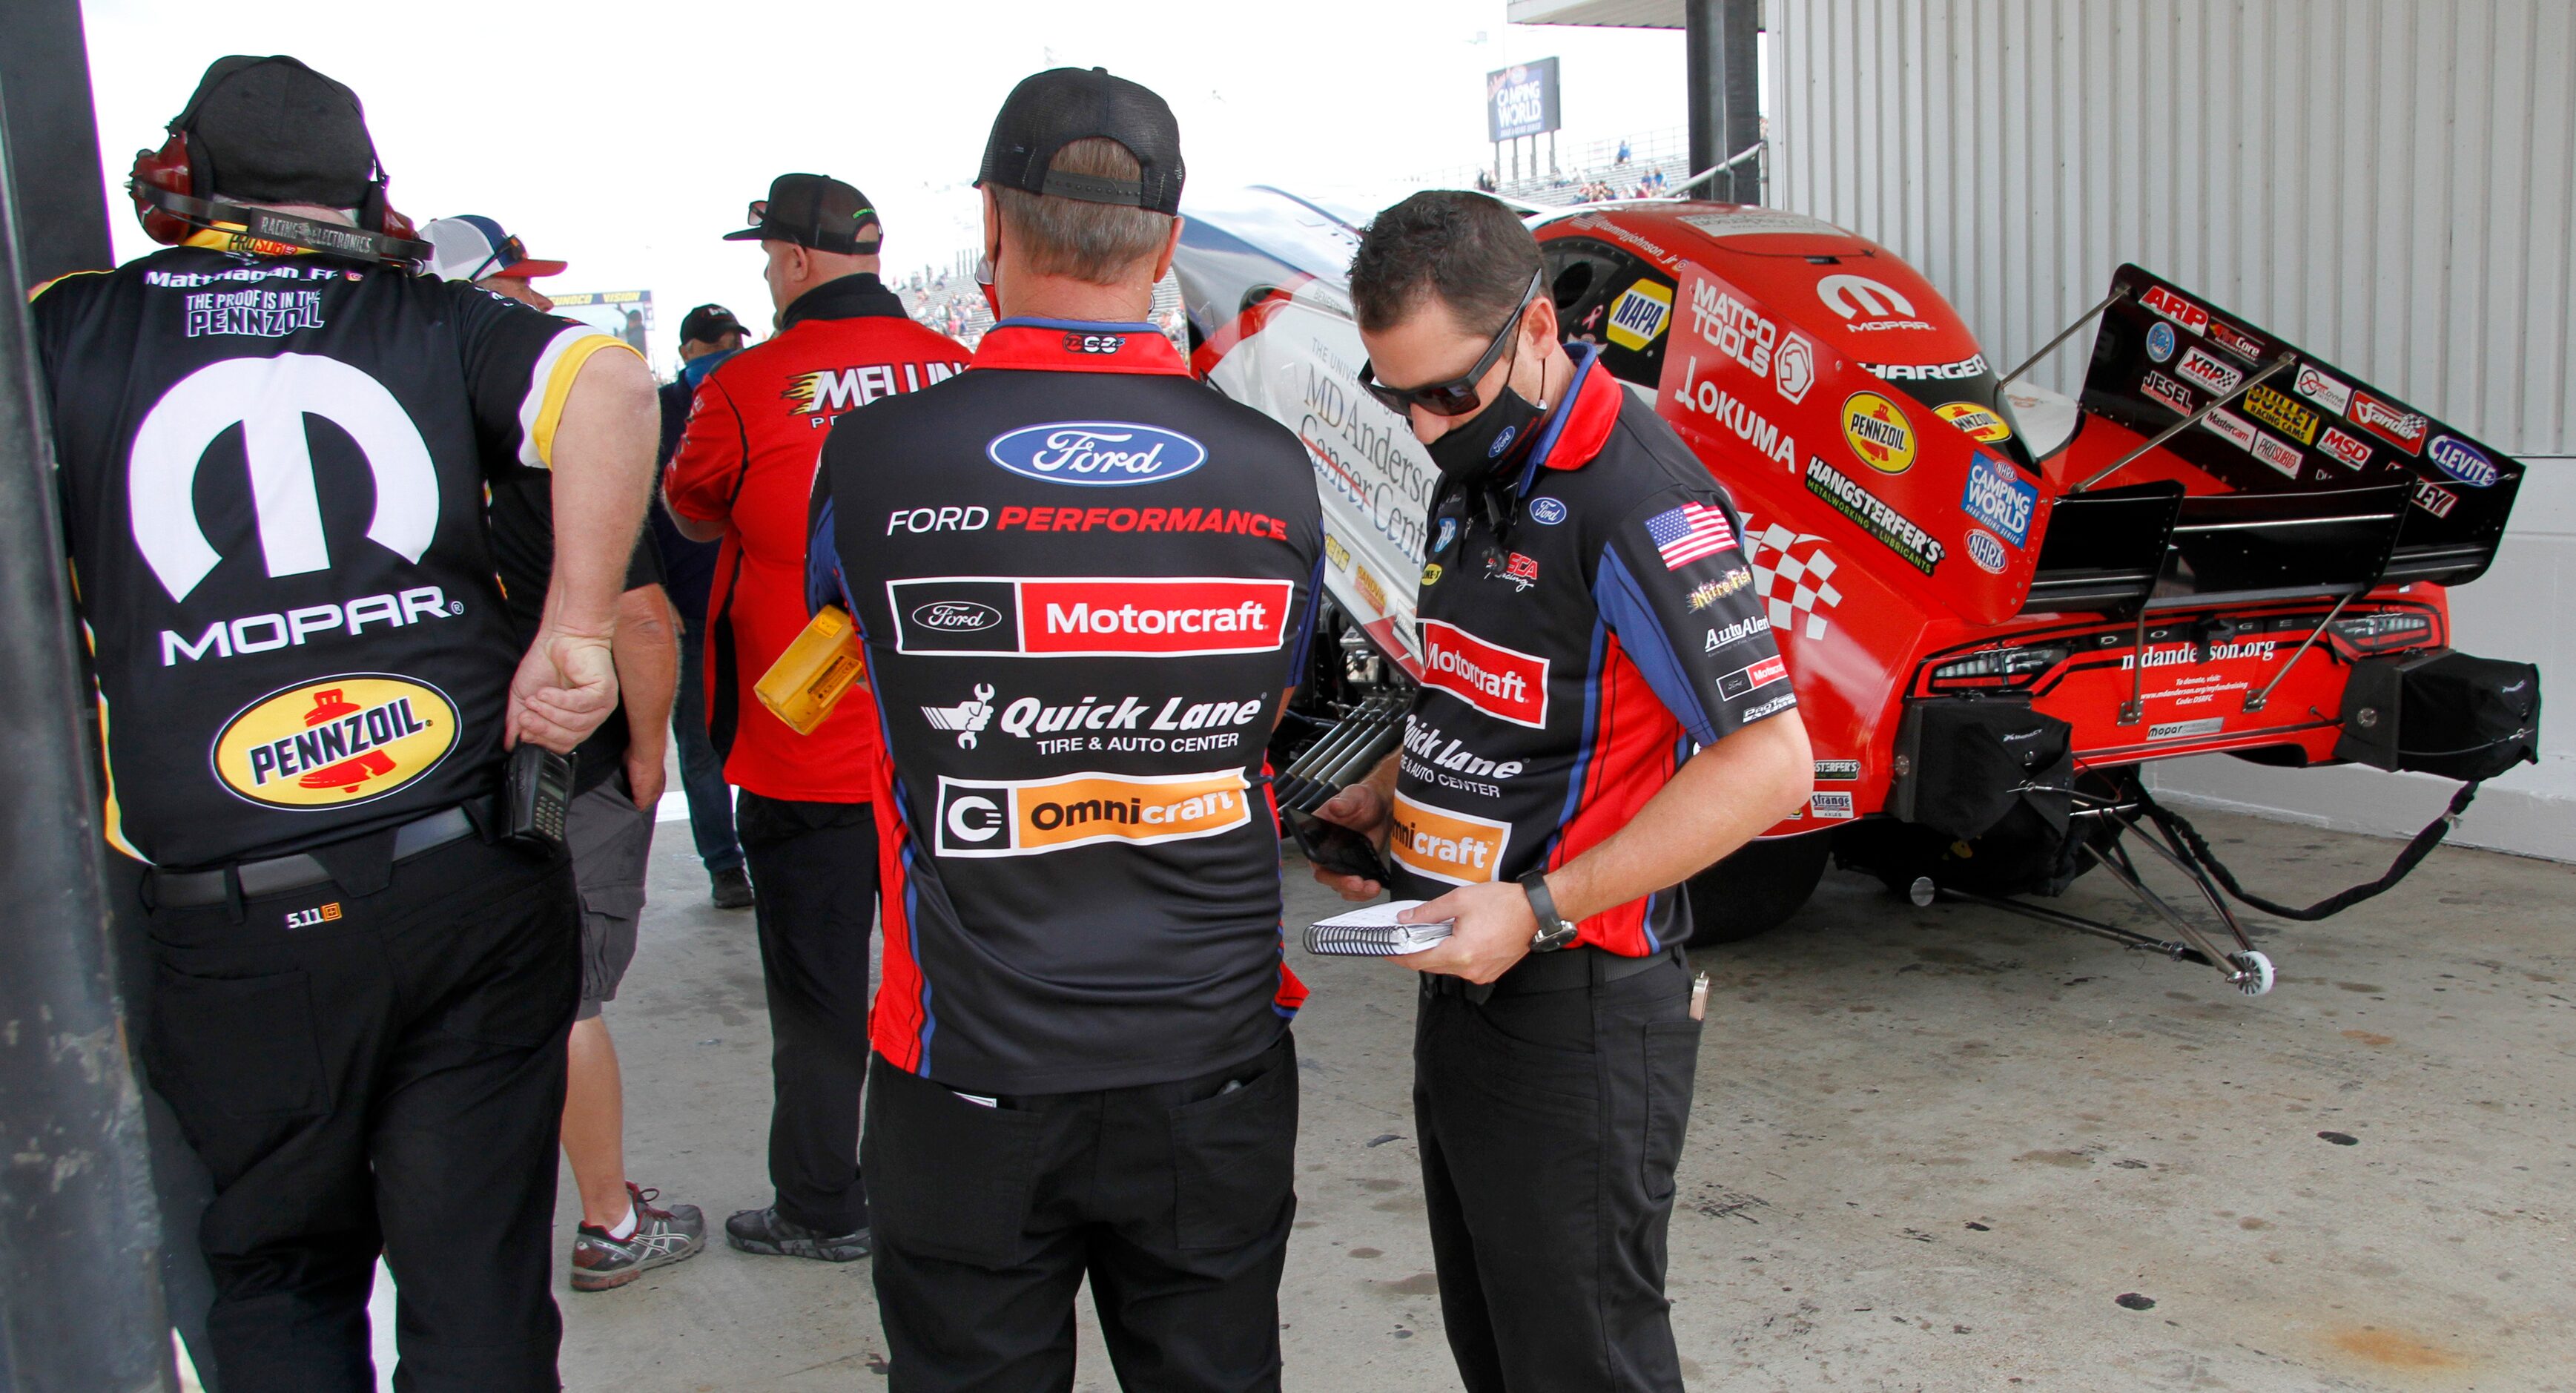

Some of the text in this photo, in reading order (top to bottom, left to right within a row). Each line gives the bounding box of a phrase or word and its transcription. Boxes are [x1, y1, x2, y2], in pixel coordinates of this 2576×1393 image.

[1497, 80, 1540, 107] CAMPING
[1498, 99, 1542, 127] WORLD
[311, 225, 373, 254] ELECTRONICS
[187, 288, 322, 312] THE PROOF IS IN THE
[603, 292, 641, 303] VISION
[1692, 277, 1777, 349] MATCO
[2141, 288, 2208, 326] ARP
[188, 300, 326, 338] PENNZOIL
[1614, 294, 1664, 337] NAPA
[1846, 320, 1931, 333] MOPAR
[1312, 338, 1329, 363] THE
[1691, 303, 1771, 379] TOOLS
[1857, 353, 1989, 380] HARGER
[2184, 354, 2226, 381] XRP
[810, 362, 969, 412] MELLIN
[2144, 372, 2192, 410] JESEL
[1304, 363, 1344, 428] MD
[1341, 400, 1435, 511] Anderso
[1697, 381, 1796, 475] OKUMA
[1850, 413, 1906, 451] PENNZOIL
[2206, 412, 2250, 442] Mastercam
[2250, 404, 2305, 440] RACING CAMS
[1032, 430, 1165, 475] Ford
[1493, 431, 1511, 453] Ford
[2256, 438, 2291, 469] PROSUB
[2323, 429, 2368, 462] MSD
[1996, 461, 2015, 479] NHRA
[2428, 435, 2497, 486] CLEVITE
[1299, 413, 1427, 571] Cancer Cent
[1969, 478, 2025, 534] WORLD
[1971, 464, 2031, 516] CAMPING
[887, 506, 1288, 541] FORD PERFORMANCE
[1534, 500, 1560, 521] Ford
[1806, 455, 1941, 562] HANGSTERFER'S
[1807, 479, 1932, 573] METALWORKING LUBRICANTS
[1981, 512, 2001, 531] RACING
[1970, 536, 2002, 567] NHRA
[159, 585, 453, 667] MOPAR
[928, 600, 1265, 634] Ford Motorcraft
[2183, 676, 2205, 685] donate,
[2206, 674, 2222, 682] visit:
[1000, 696, 1263, 738] Quick Lane
[2176, 696, 2193, 705] Code:
[249, 696, 425, 787] PENNZOIL
[1037, 732, 1239, 755] TIRE & AUTO CENTER
[2147, 725, 2183, 737] Mopar
[1433, 739, 1524, 780] Lane
[1410, 763, 1434, 783] AUTO
[1437, 774, 1500, 798] CENTER
[1031, 790, 1234, 831] Omnicraft
[1812, 793, 1850, 806] Strange
[1392, 819, 1488, 869] mnicraft
[285, 908, 323, 929] 5.11
